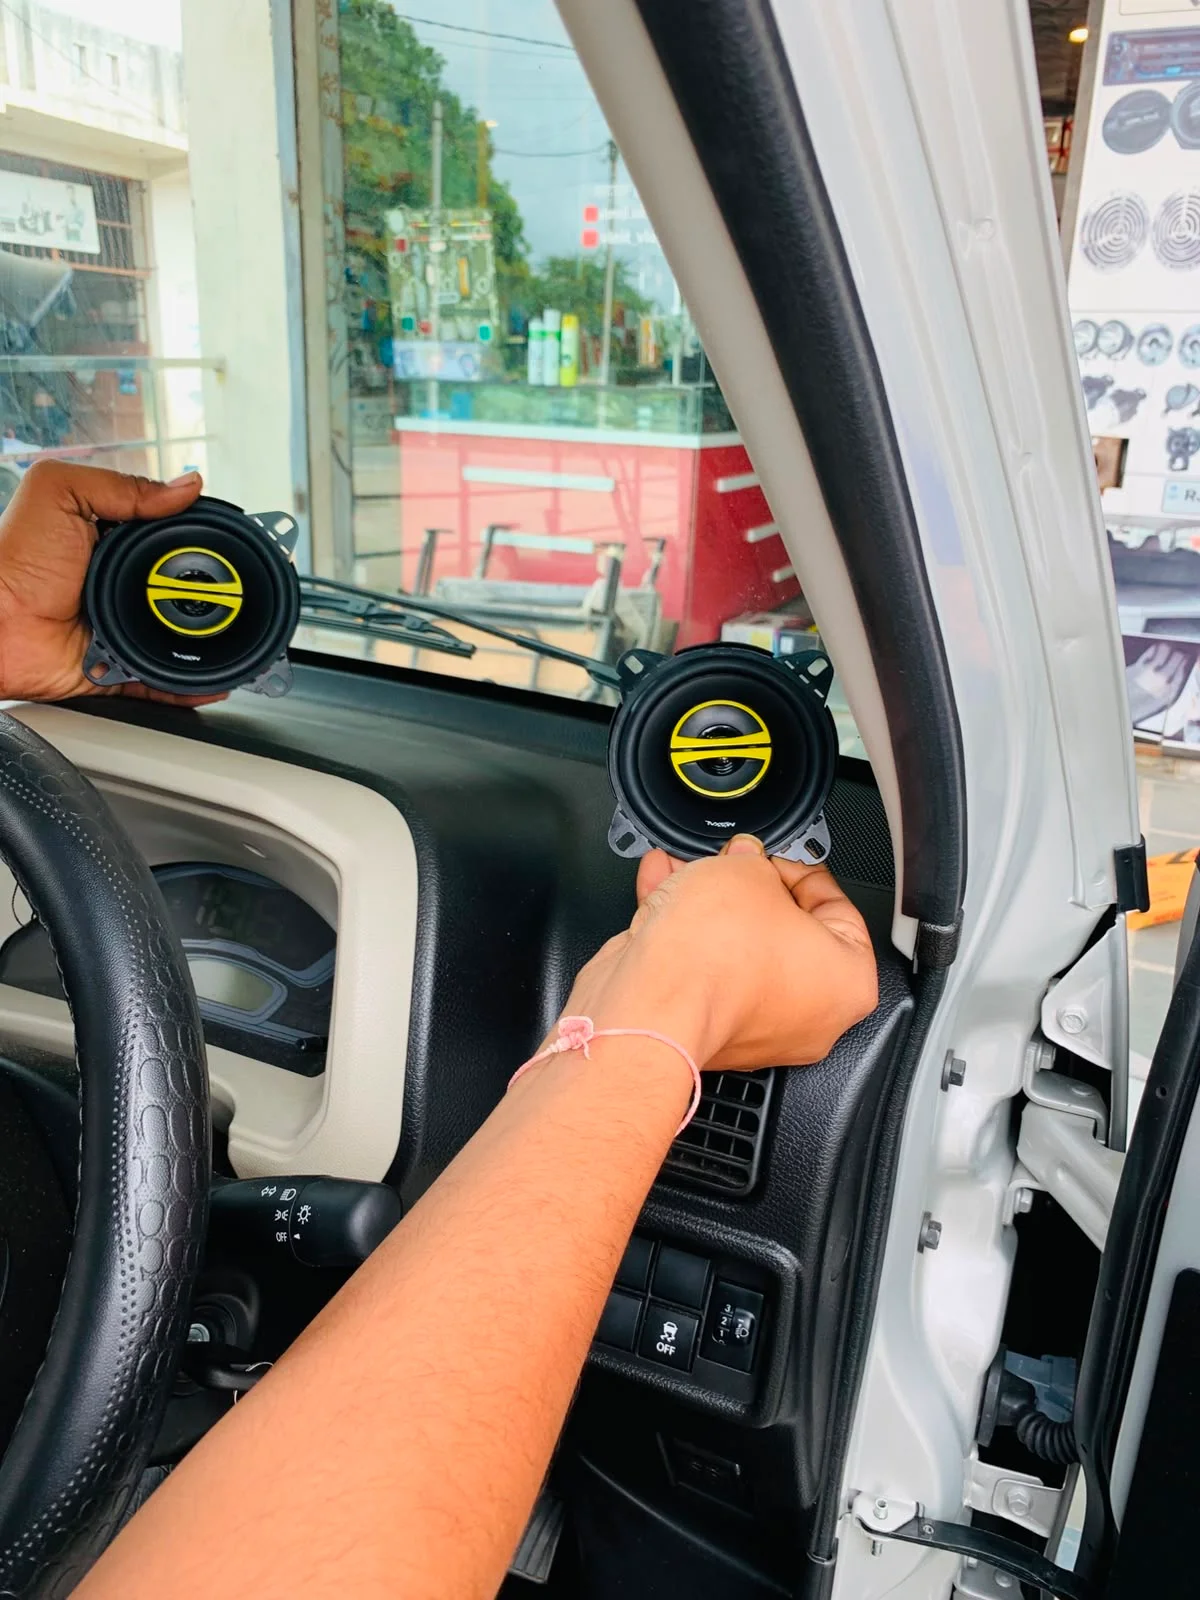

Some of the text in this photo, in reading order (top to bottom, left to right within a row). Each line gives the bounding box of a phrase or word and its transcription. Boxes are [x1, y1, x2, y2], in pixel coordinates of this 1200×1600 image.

[275, 1231, 287, 1242] OFF
[724, 1303, 732, 1313] 3
[721, 1316, 728, 1326] 2
[656, 1341, 676, 1356] OFF
